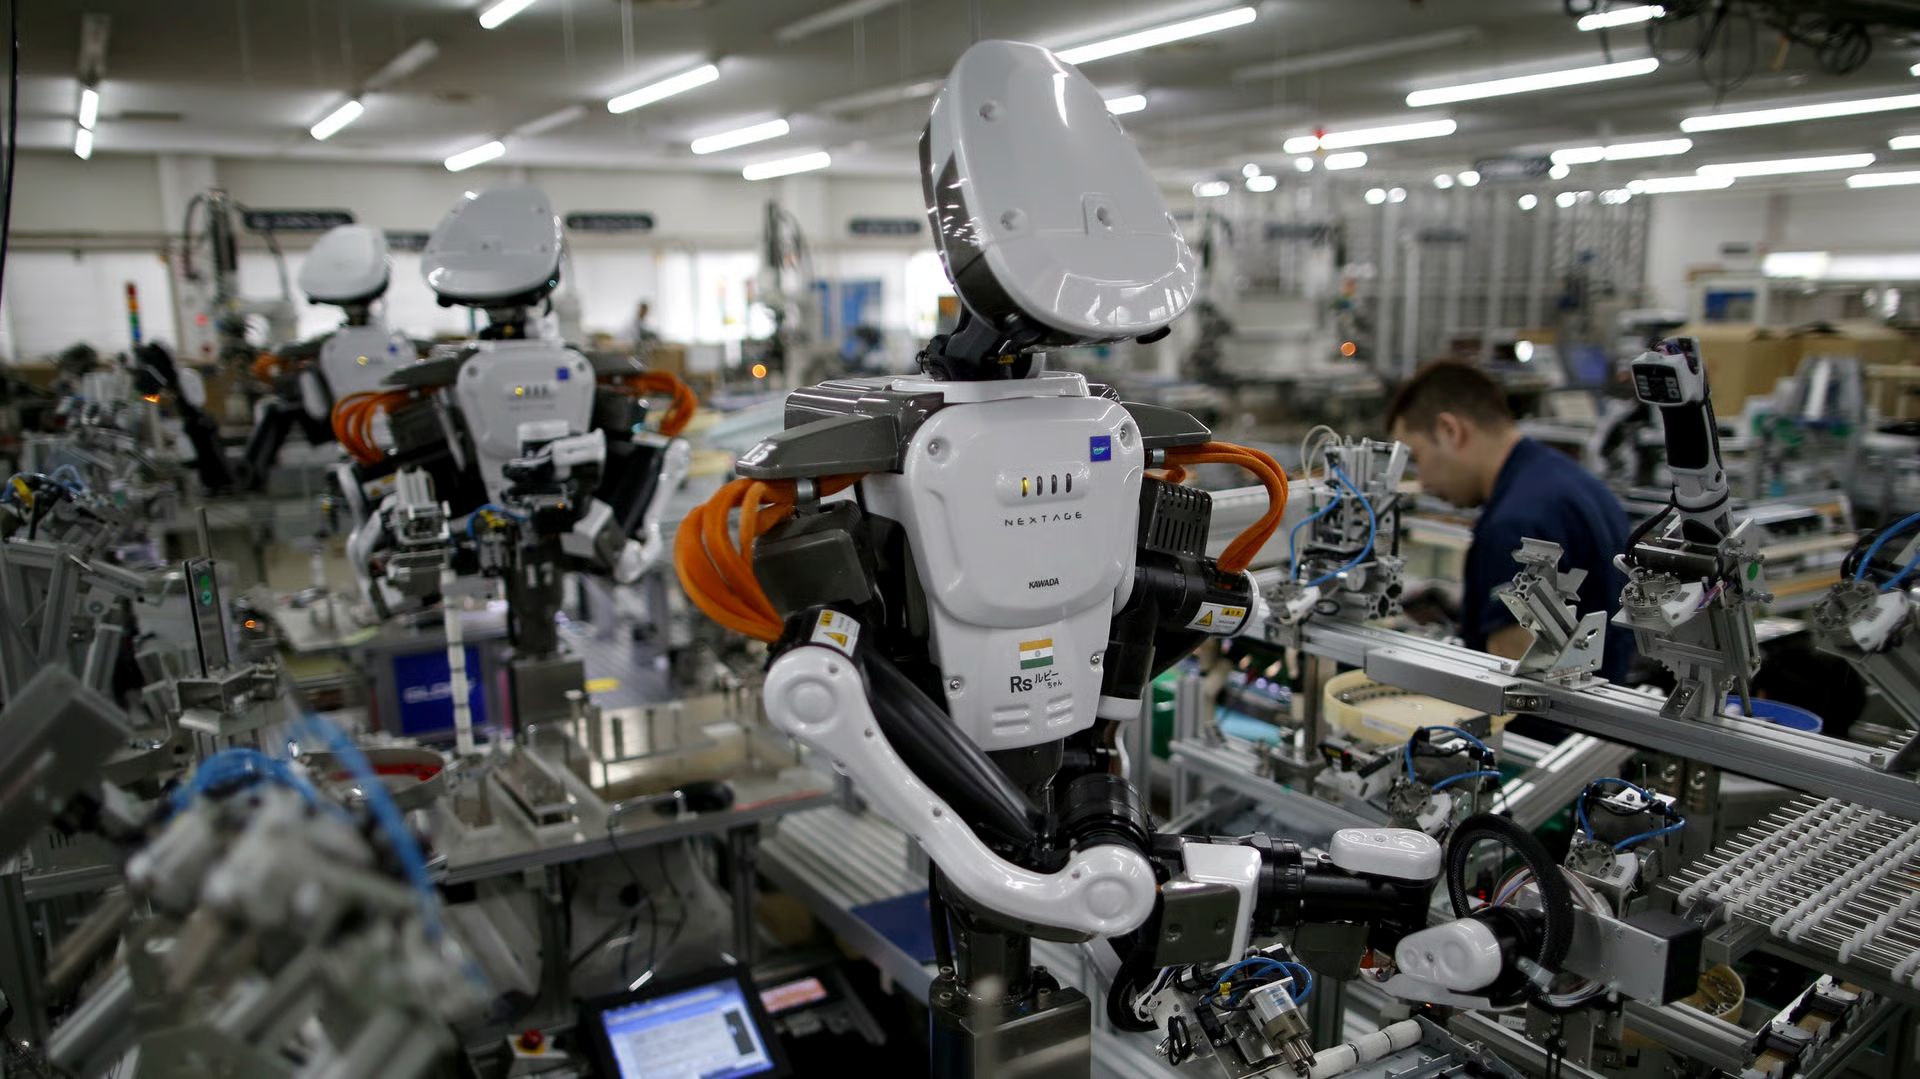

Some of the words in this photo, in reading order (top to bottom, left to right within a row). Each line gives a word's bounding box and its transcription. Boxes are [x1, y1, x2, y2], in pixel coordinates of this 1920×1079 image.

[1004, 511, 1082, 526] NEXTAGE
[1028, 578, 1059, 589] KAWADA
[1010, 675, 1033, 693] Rs
[1034, 669, 1059, 684] ルビー
